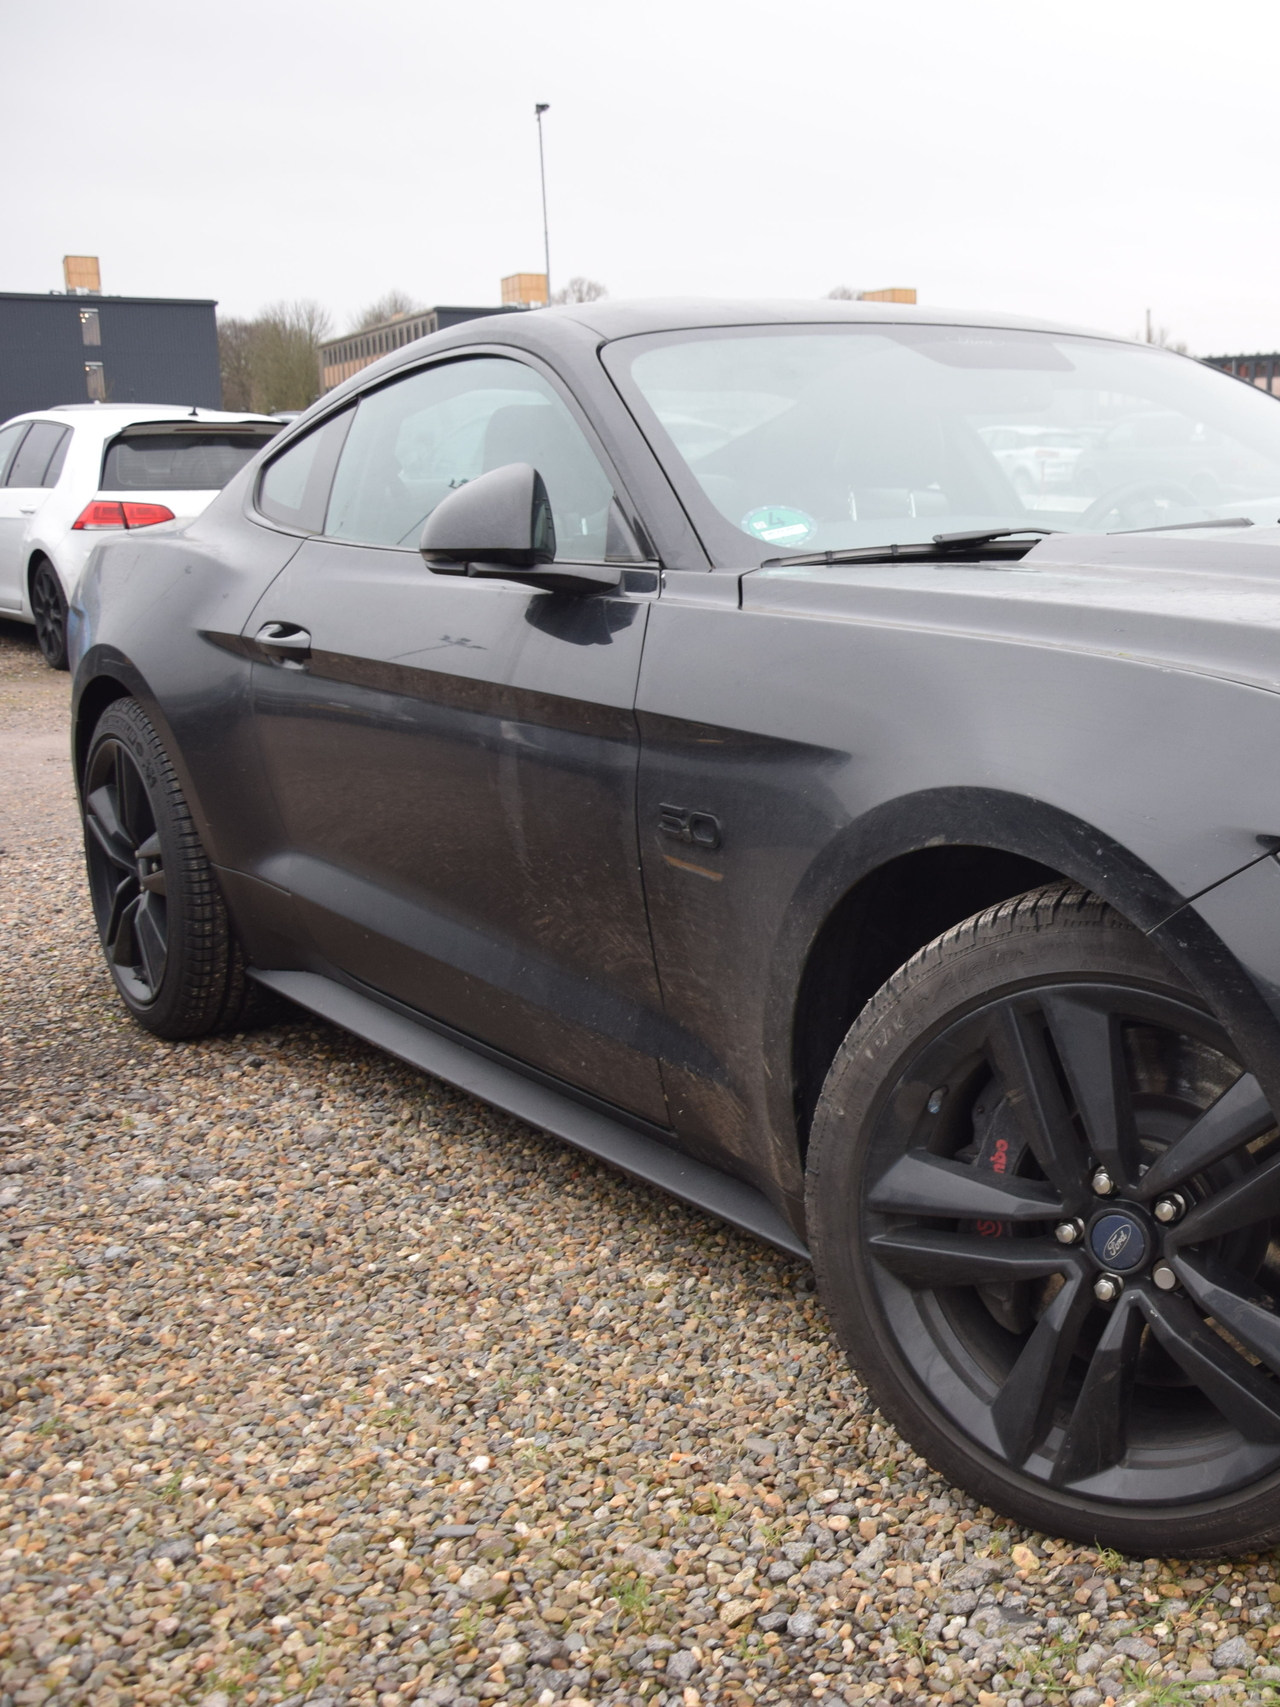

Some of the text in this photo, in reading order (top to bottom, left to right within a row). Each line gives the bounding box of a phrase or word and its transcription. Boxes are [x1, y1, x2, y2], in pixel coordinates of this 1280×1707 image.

[767, 511, 785, 526] 4
[658, 801, 722, 849] 5.0
[1106, 1228, 1129, 1257] Ford
